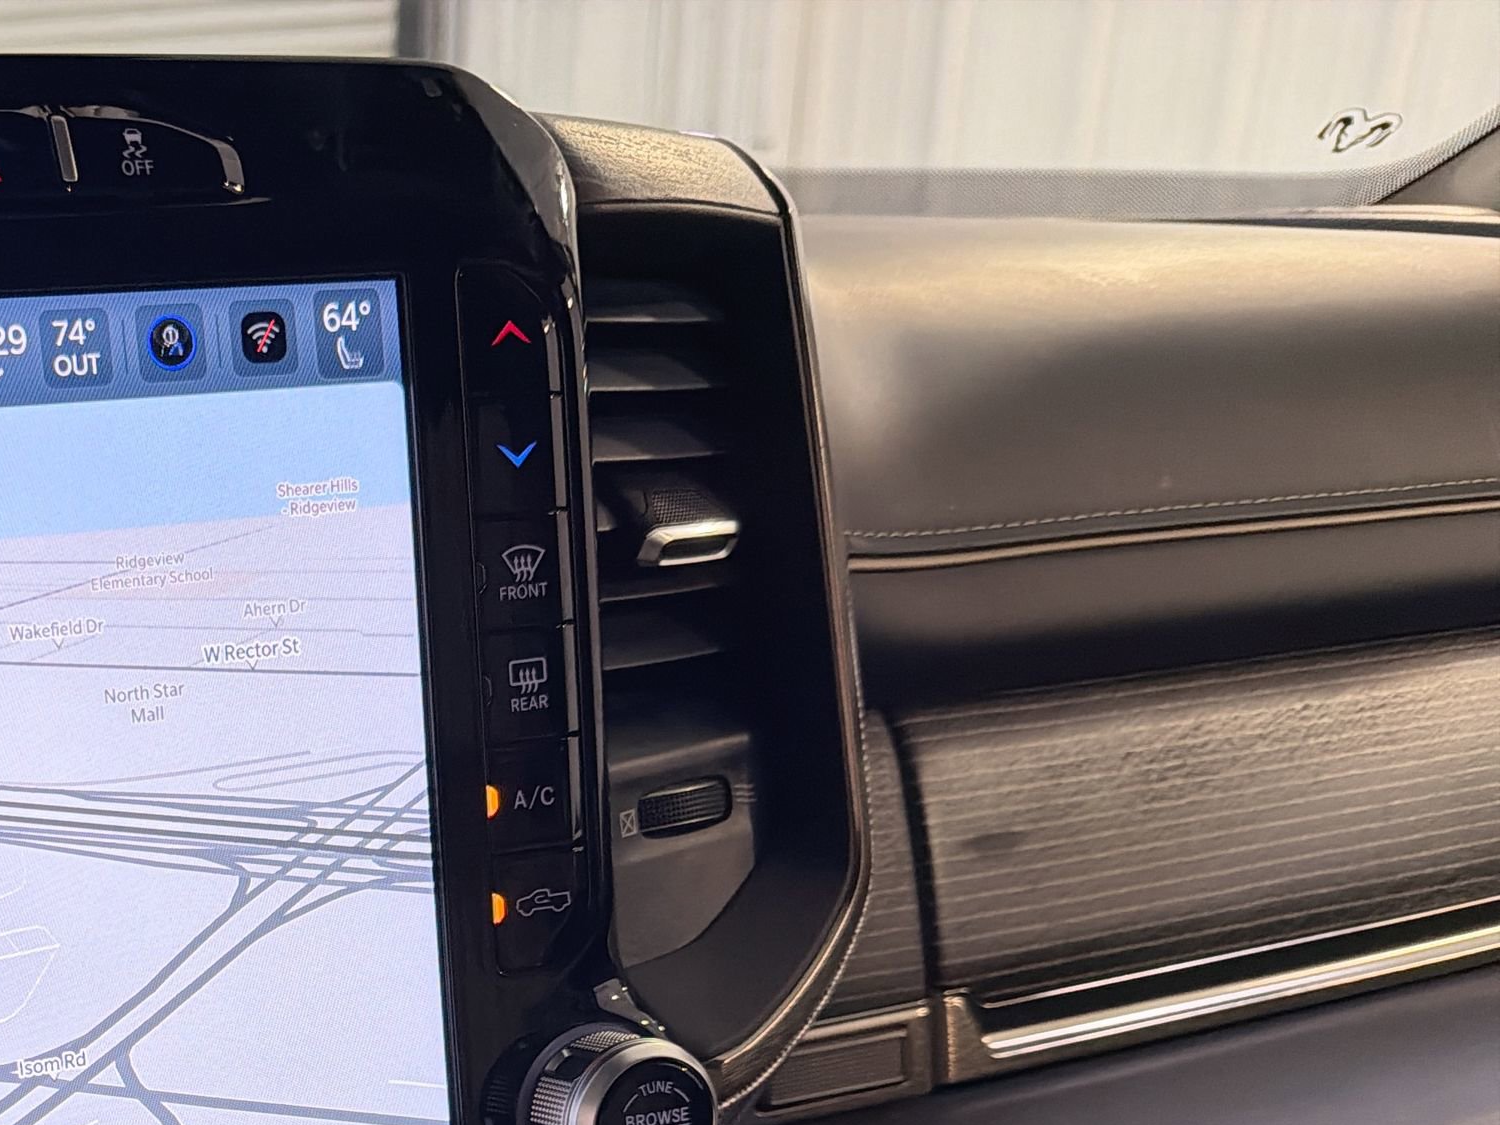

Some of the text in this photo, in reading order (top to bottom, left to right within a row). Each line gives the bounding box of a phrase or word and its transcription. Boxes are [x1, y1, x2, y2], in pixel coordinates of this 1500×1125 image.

[121, 159, 154, 177] OFF
[54, 352, 101, 377] OUT
[277, 478, 359, 498] Shearer Hills
[290, 499, 357, 517] Ridgeview
[116, 553, 185, 571] Ridgeview
[91, 567, 214, 591] Elementary School
[500, 582, 548, 601] FRONT
[243, 599, 307, 618] Ahern Dr
[10, 619, 103, 641] Wakefield Dr
[204, 638, 300, 663] W Rector St
[104, 683, 185, 704] North Star
[510, 695, 549, 713] REAR
[131, 706, 165, 724] Mall
[513, 785, 556, 810] A/C
[19, 1051, 87, 1076] Isom Rd
[637, 1080, 675, 1097] TUNE
